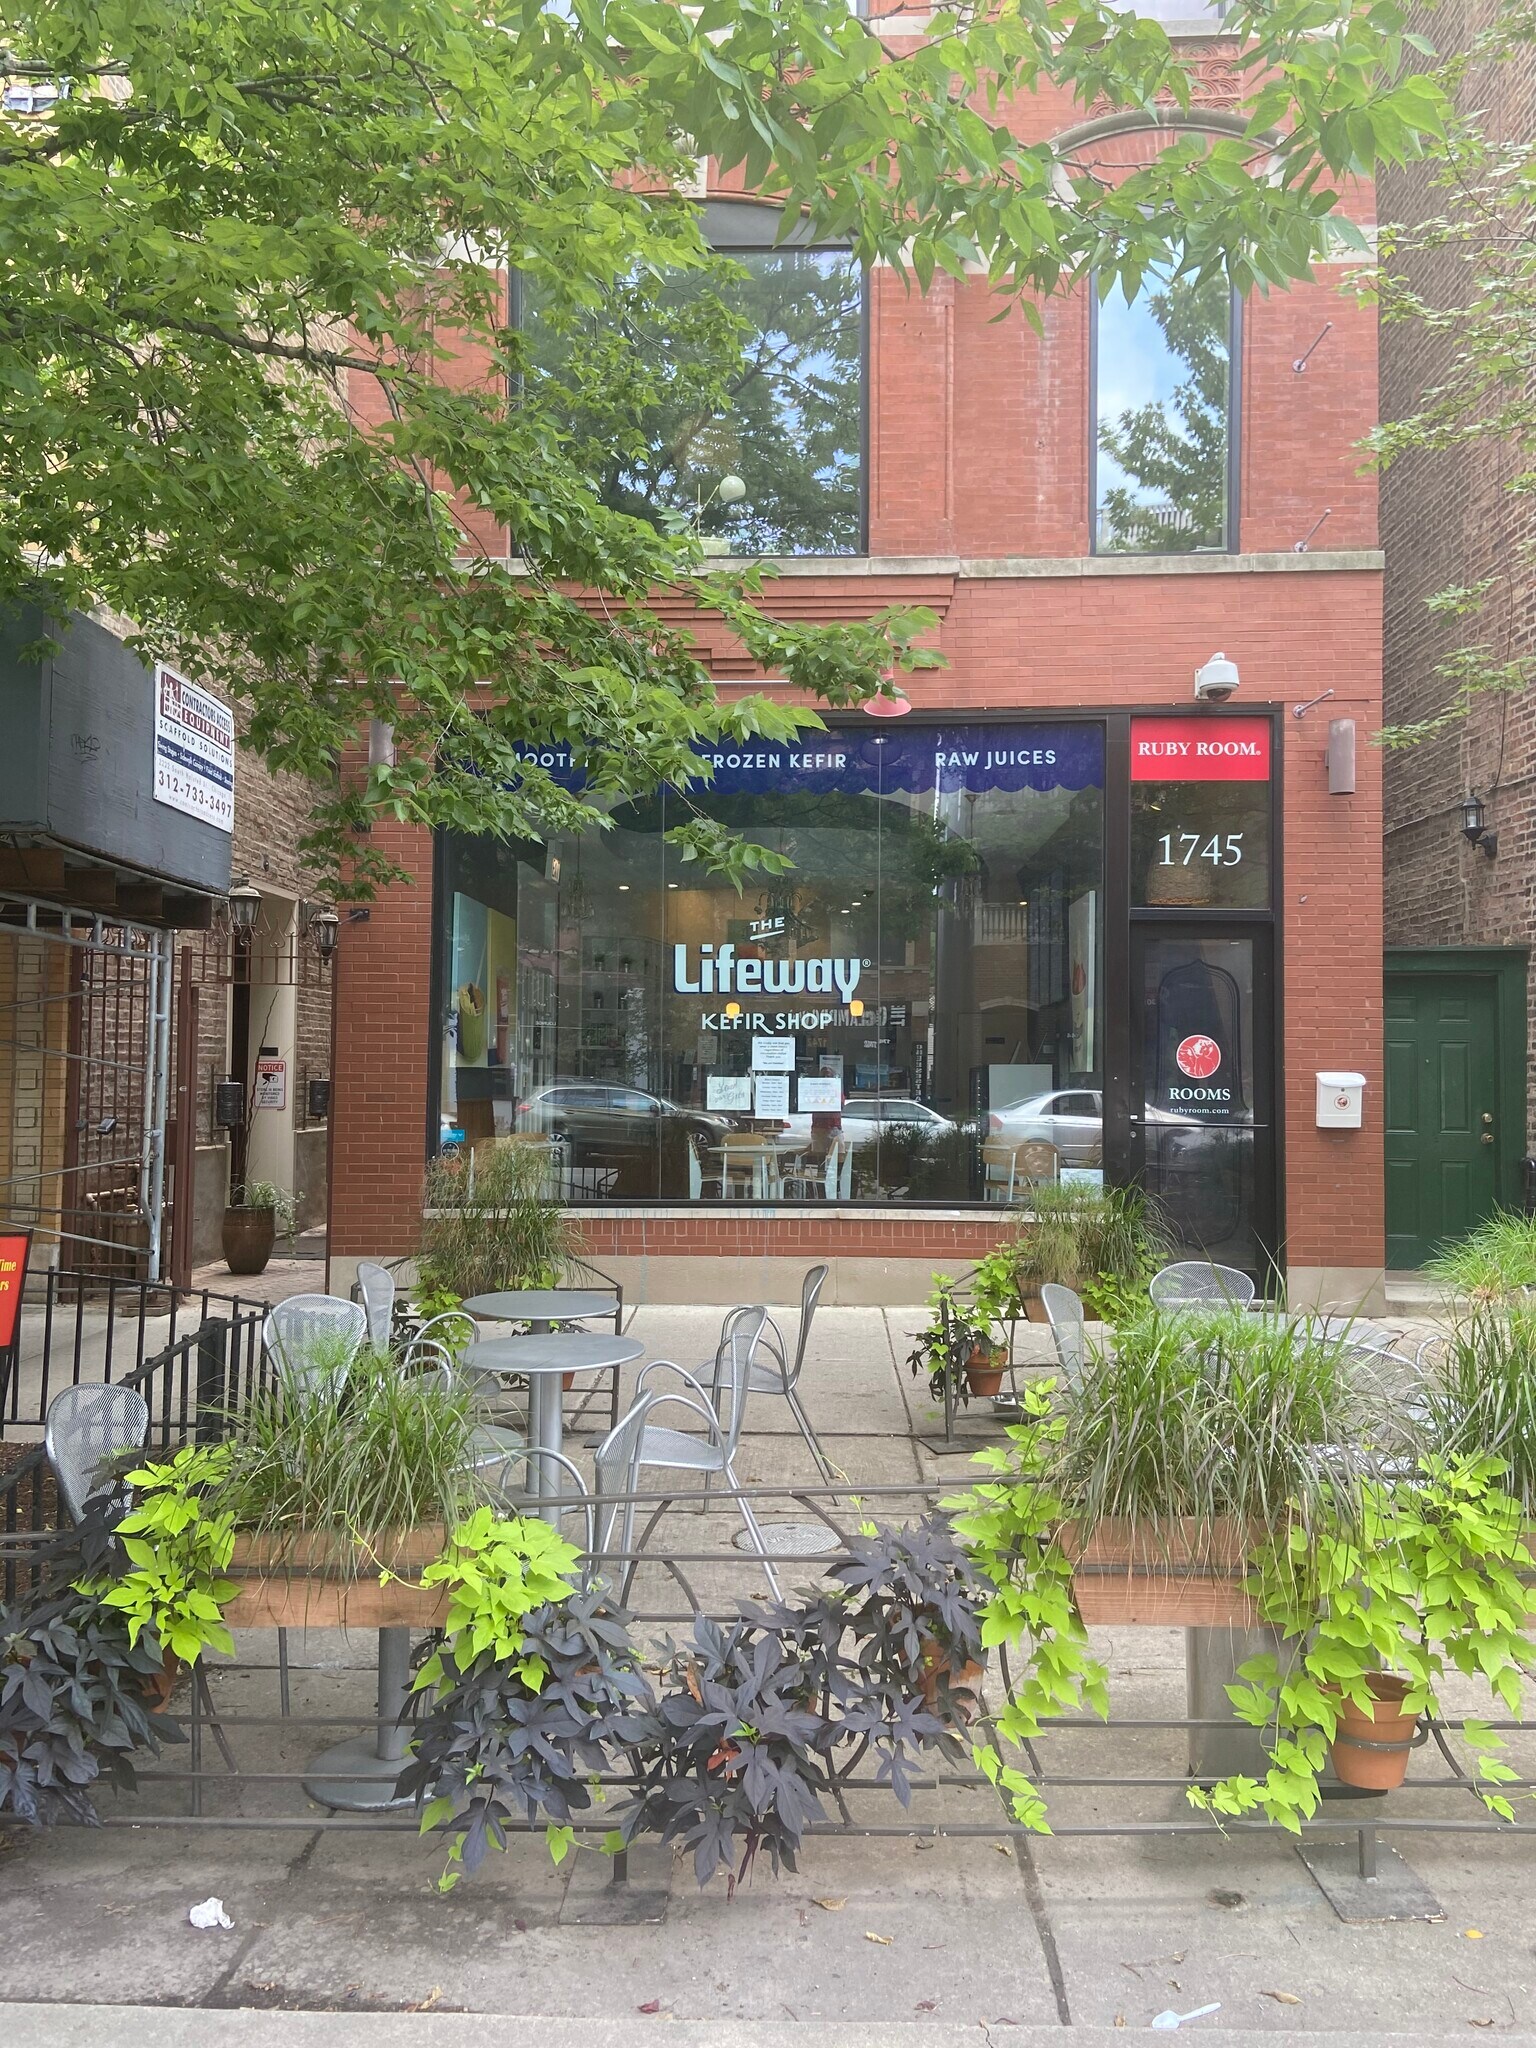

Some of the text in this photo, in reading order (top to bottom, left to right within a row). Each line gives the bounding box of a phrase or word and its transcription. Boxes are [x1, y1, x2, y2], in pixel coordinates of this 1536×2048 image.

[182, 691, 231, 733] CONTRACTORS ACCESS
[184, 711, 229, 746] EQUIPMENT
[160, 720, 232, 767] SCAFFOLD SOLUTIONS
[1138, 742, 1192, 756] RUBY
[790, 753, 847, 768] KEFIR
[935, 750, 1056, 770] RAW JUICES
[158, 770, 232, 818] 312-733-3497
[1158, 832, 1243, 866] 1745
[750, 917, 784, 932] THE
[701, 1013, 774, 1034] KEFIR
[775, 1013, 833, 1030] SHOP
[1169, 1087, 1231, 1100] ROOMS
[1170, 1107, 1230, 1115] rubyroom.com
